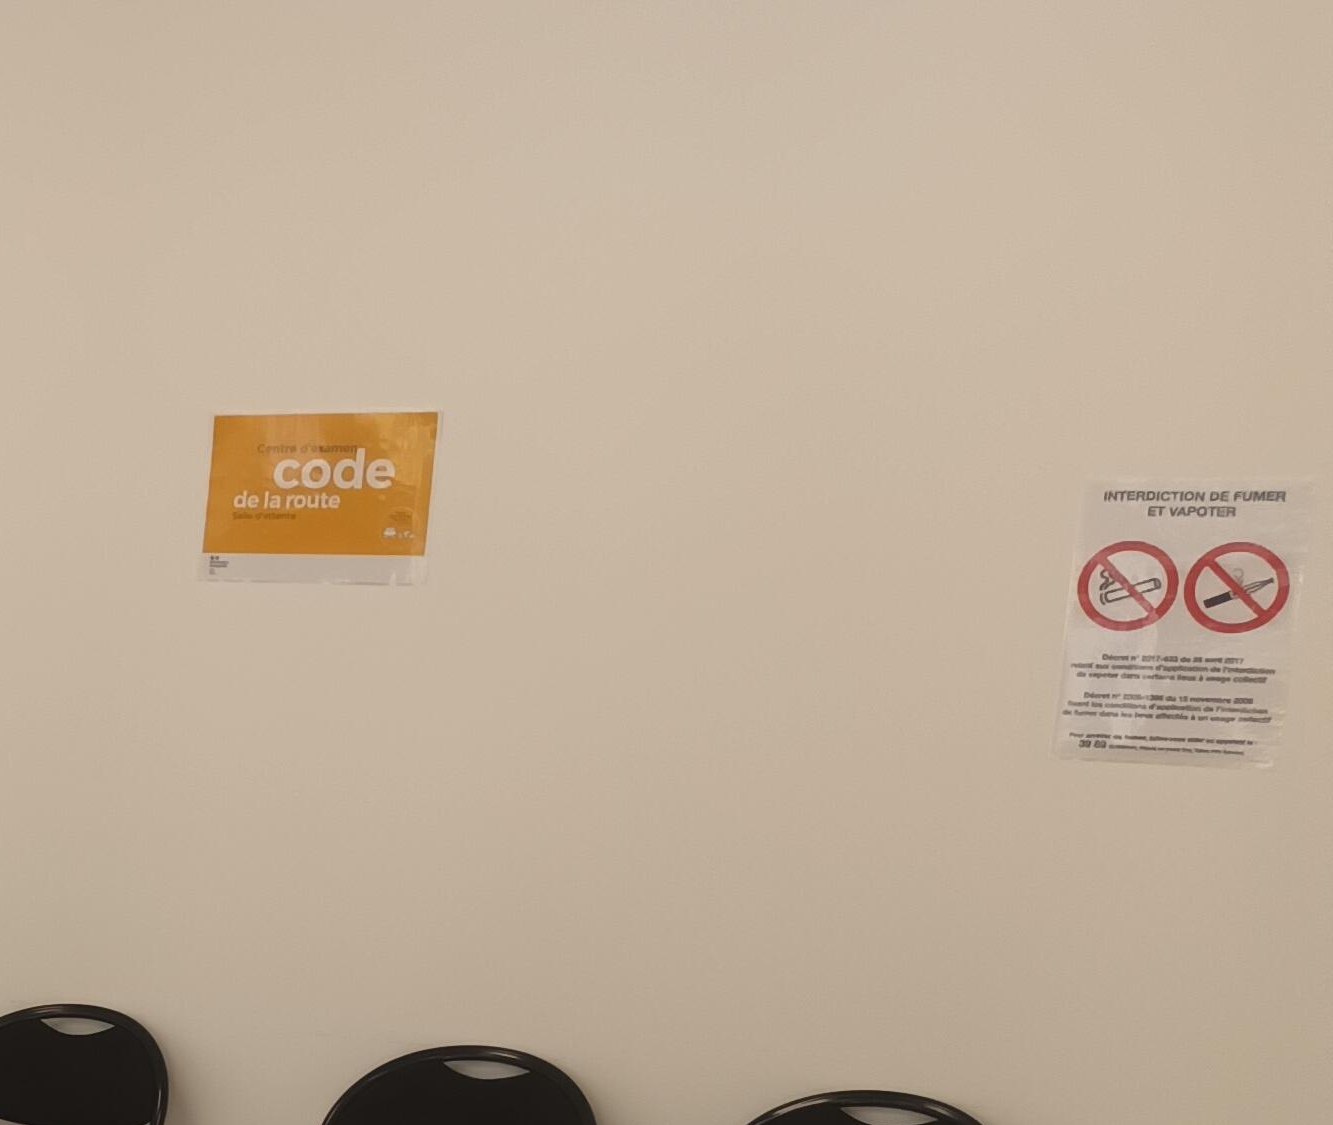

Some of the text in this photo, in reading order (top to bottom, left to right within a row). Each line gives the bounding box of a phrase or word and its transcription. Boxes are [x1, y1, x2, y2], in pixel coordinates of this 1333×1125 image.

[273, 448, 396, 490] code
[234, 490, 341, 510] de la route
[1103, 490, 1287, 502] INTERDICTION DE FUMER
[1147, 506, 1236, 518] ET VAPOTER
